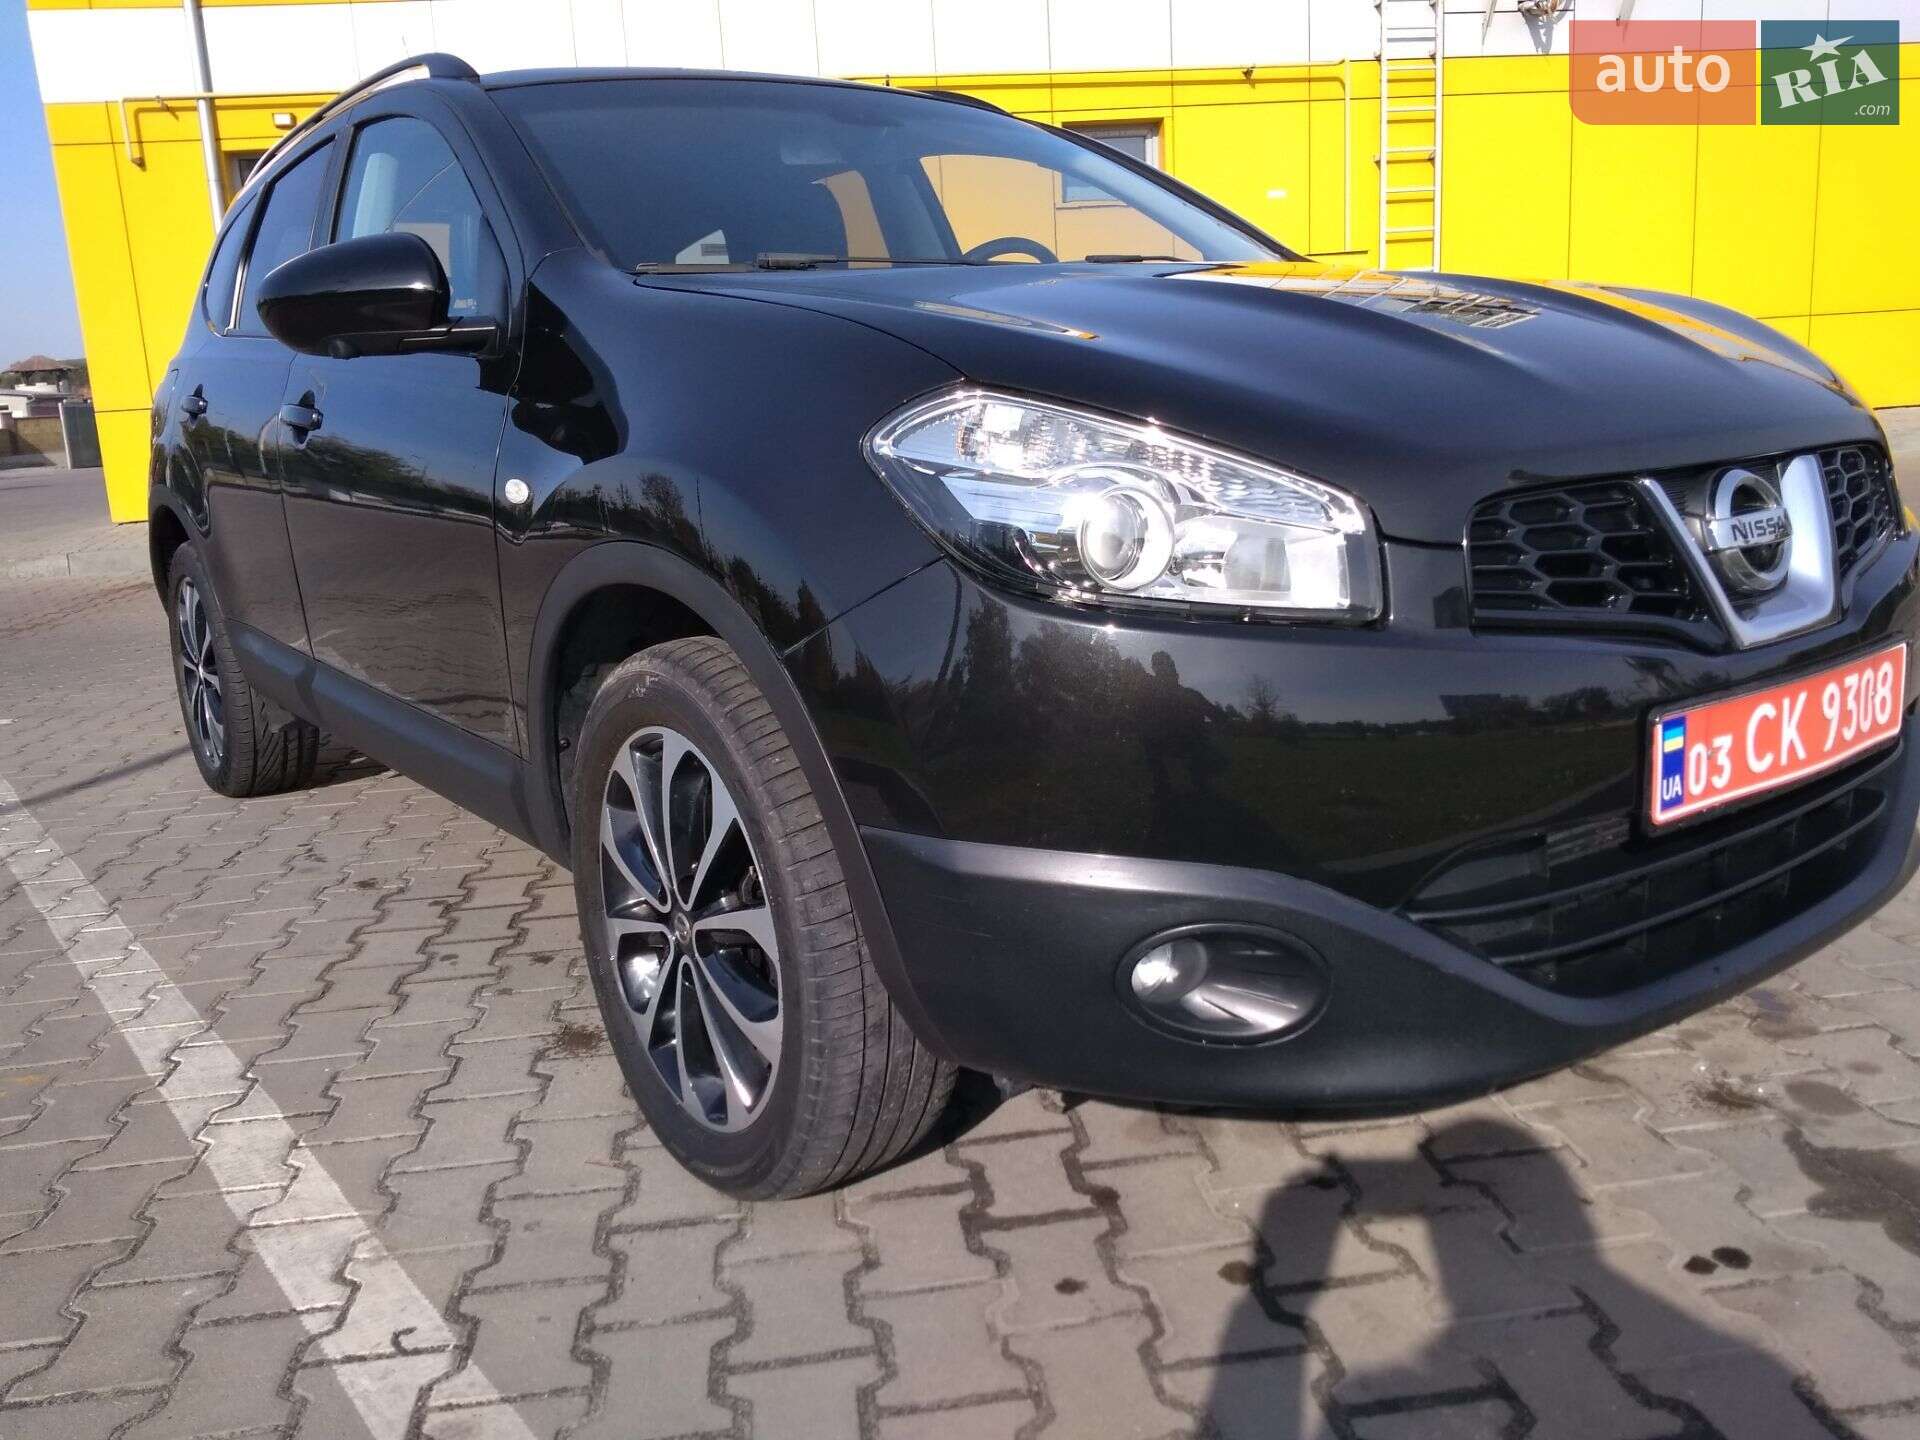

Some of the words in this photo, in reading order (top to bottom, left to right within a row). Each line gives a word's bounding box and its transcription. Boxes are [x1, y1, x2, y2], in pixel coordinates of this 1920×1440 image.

[1688, 735, 1733, 796] 03
[1746, 692, 1808, 774] CK
[1822, 661, 1894, 752] 9308
[1662, 774, 1683, 801] UA
